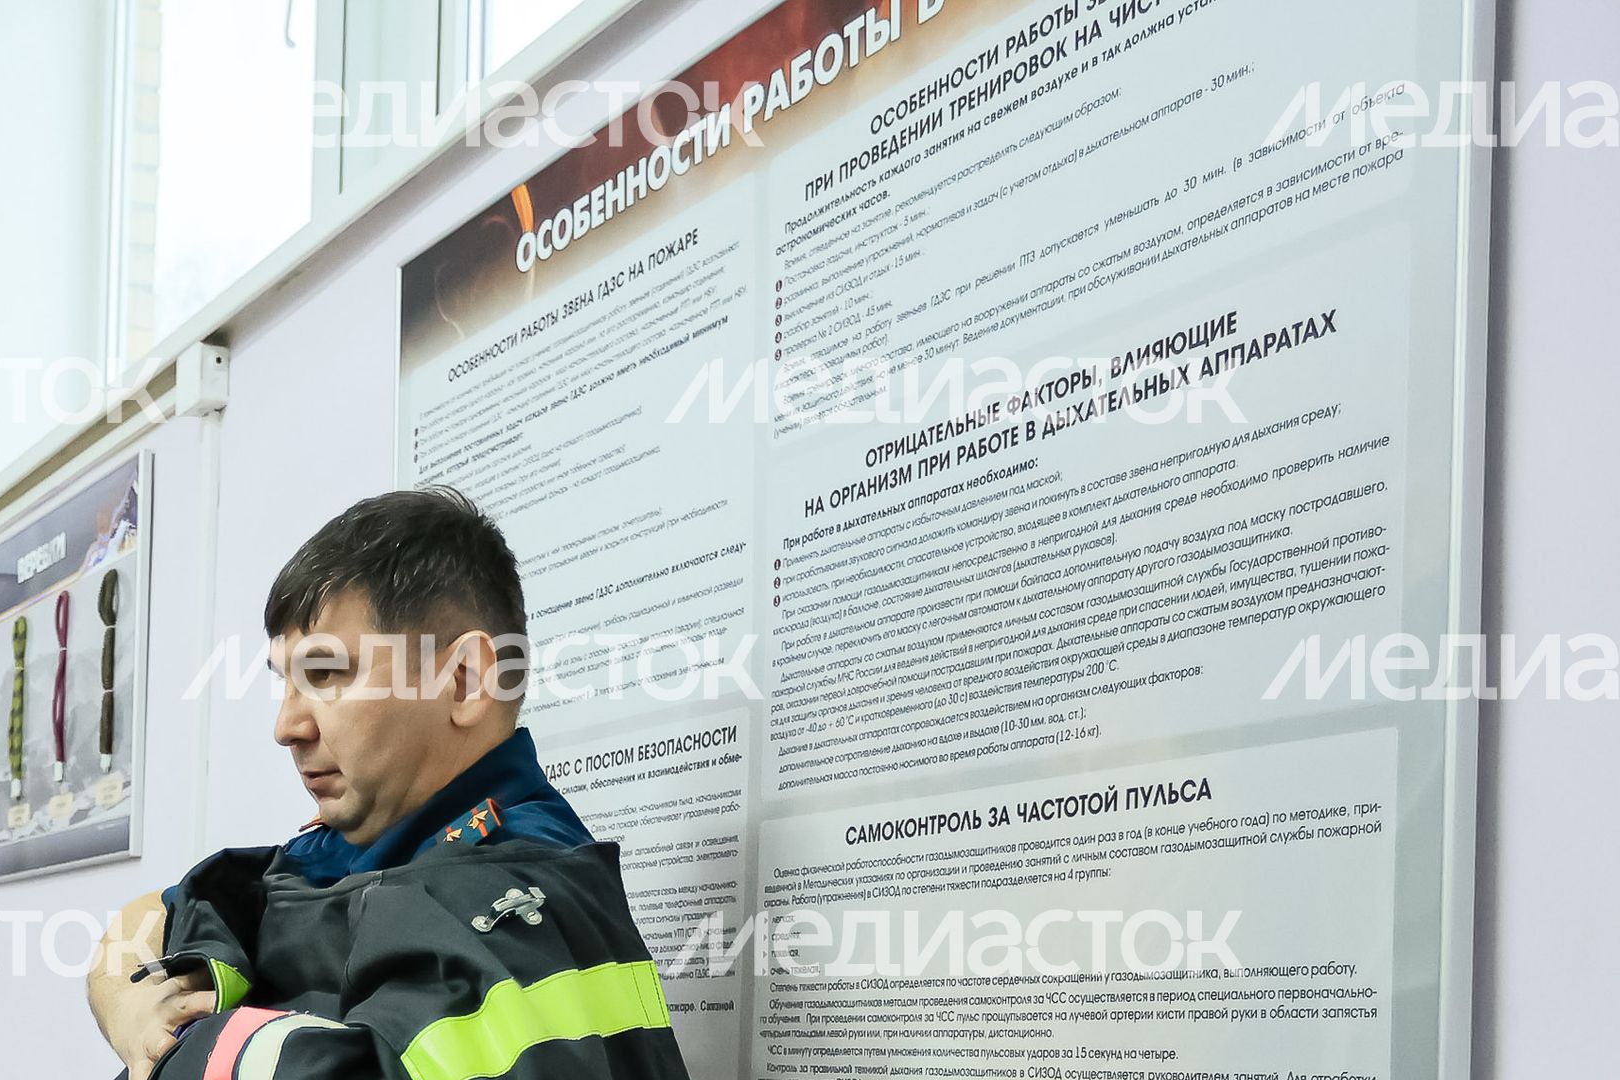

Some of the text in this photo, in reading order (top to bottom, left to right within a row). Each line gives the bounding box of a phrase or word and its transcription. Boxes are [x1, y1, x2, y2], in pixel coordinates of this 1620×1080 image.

[784, 178, 878, 235] Продолжительность
[878, 153, 922, 184] каждого
[922, 128, 966, 160] занятия
[966, 119, 982, 136] на
[983, 93, 1029, 127] свежем
[1030, 66, 1079, 102] воздухе
[1080, 60, 1090, 74] и
[1091, 55, 1099, 68] в
[1123, 13, 1175, 53] должна
[804, 169, 834, 202] ПРИ
[838, 106, 944, 184] ПРОВЕДЕНИИ
[948, 35, 1068, 122] ТРЕНИРОВОК
[1074, 18, 1103, 52] НА
[869, 0, 1079, 136] ОСОБЕННОСТИ РАБОТЫ
[514, 0, 903, 274] ОСОБЕННОСТИ РАБОТЫ
[1038, 82, 1406, 260] допускается уменьшать до 30 мин. (в зависимости от объекта
[1086, 148, 1404, 293] обслуживании дыхательных аппаратов на месте пожара
[447, 227, 699, 383] ОСОБЕННОСТИ РАБОТЫ ЗВЕНА ГДЗС НА ПОЖАРЕ
[804, 308, 1337, 519] НА ОРГАНИЗМ ПРИ РАБОТЕ В ДЫХАТЕЛЬНЫХ АППАРАТАХ
[864, 310, 1238, 469] ОТРИЦАТЕЛЬНЫЕ ФАКТОРЫ, ВЛИЯЮЩИЕ
[782, 456, 1039, 552] При работе в дыхательных аппаратах необходимо:
[1163, 435, 1391, 512] среде необходимо проверить наличие
[544, 724, 738, 784] ГДЗС С ПОСТОМ БЕЗОПАСНОСТИ
[844, 777, 1213, 846] САМОКОНТРОЛЬ ЗА ЧАСТОТОЙ ПУЛЬСА
[1143, 802, 1383, 841] (в конце учебного года) по методике, при-
[1148, 986, 1378, 1005] в период специального первоначально-
[1187, 1003, 1378, 1023] правой руки в области запястья
[1222, 959, 1358, 980] выполняющего работу.
[1060, 1045, 1180, 1064] за 15 секунд на четыре.
